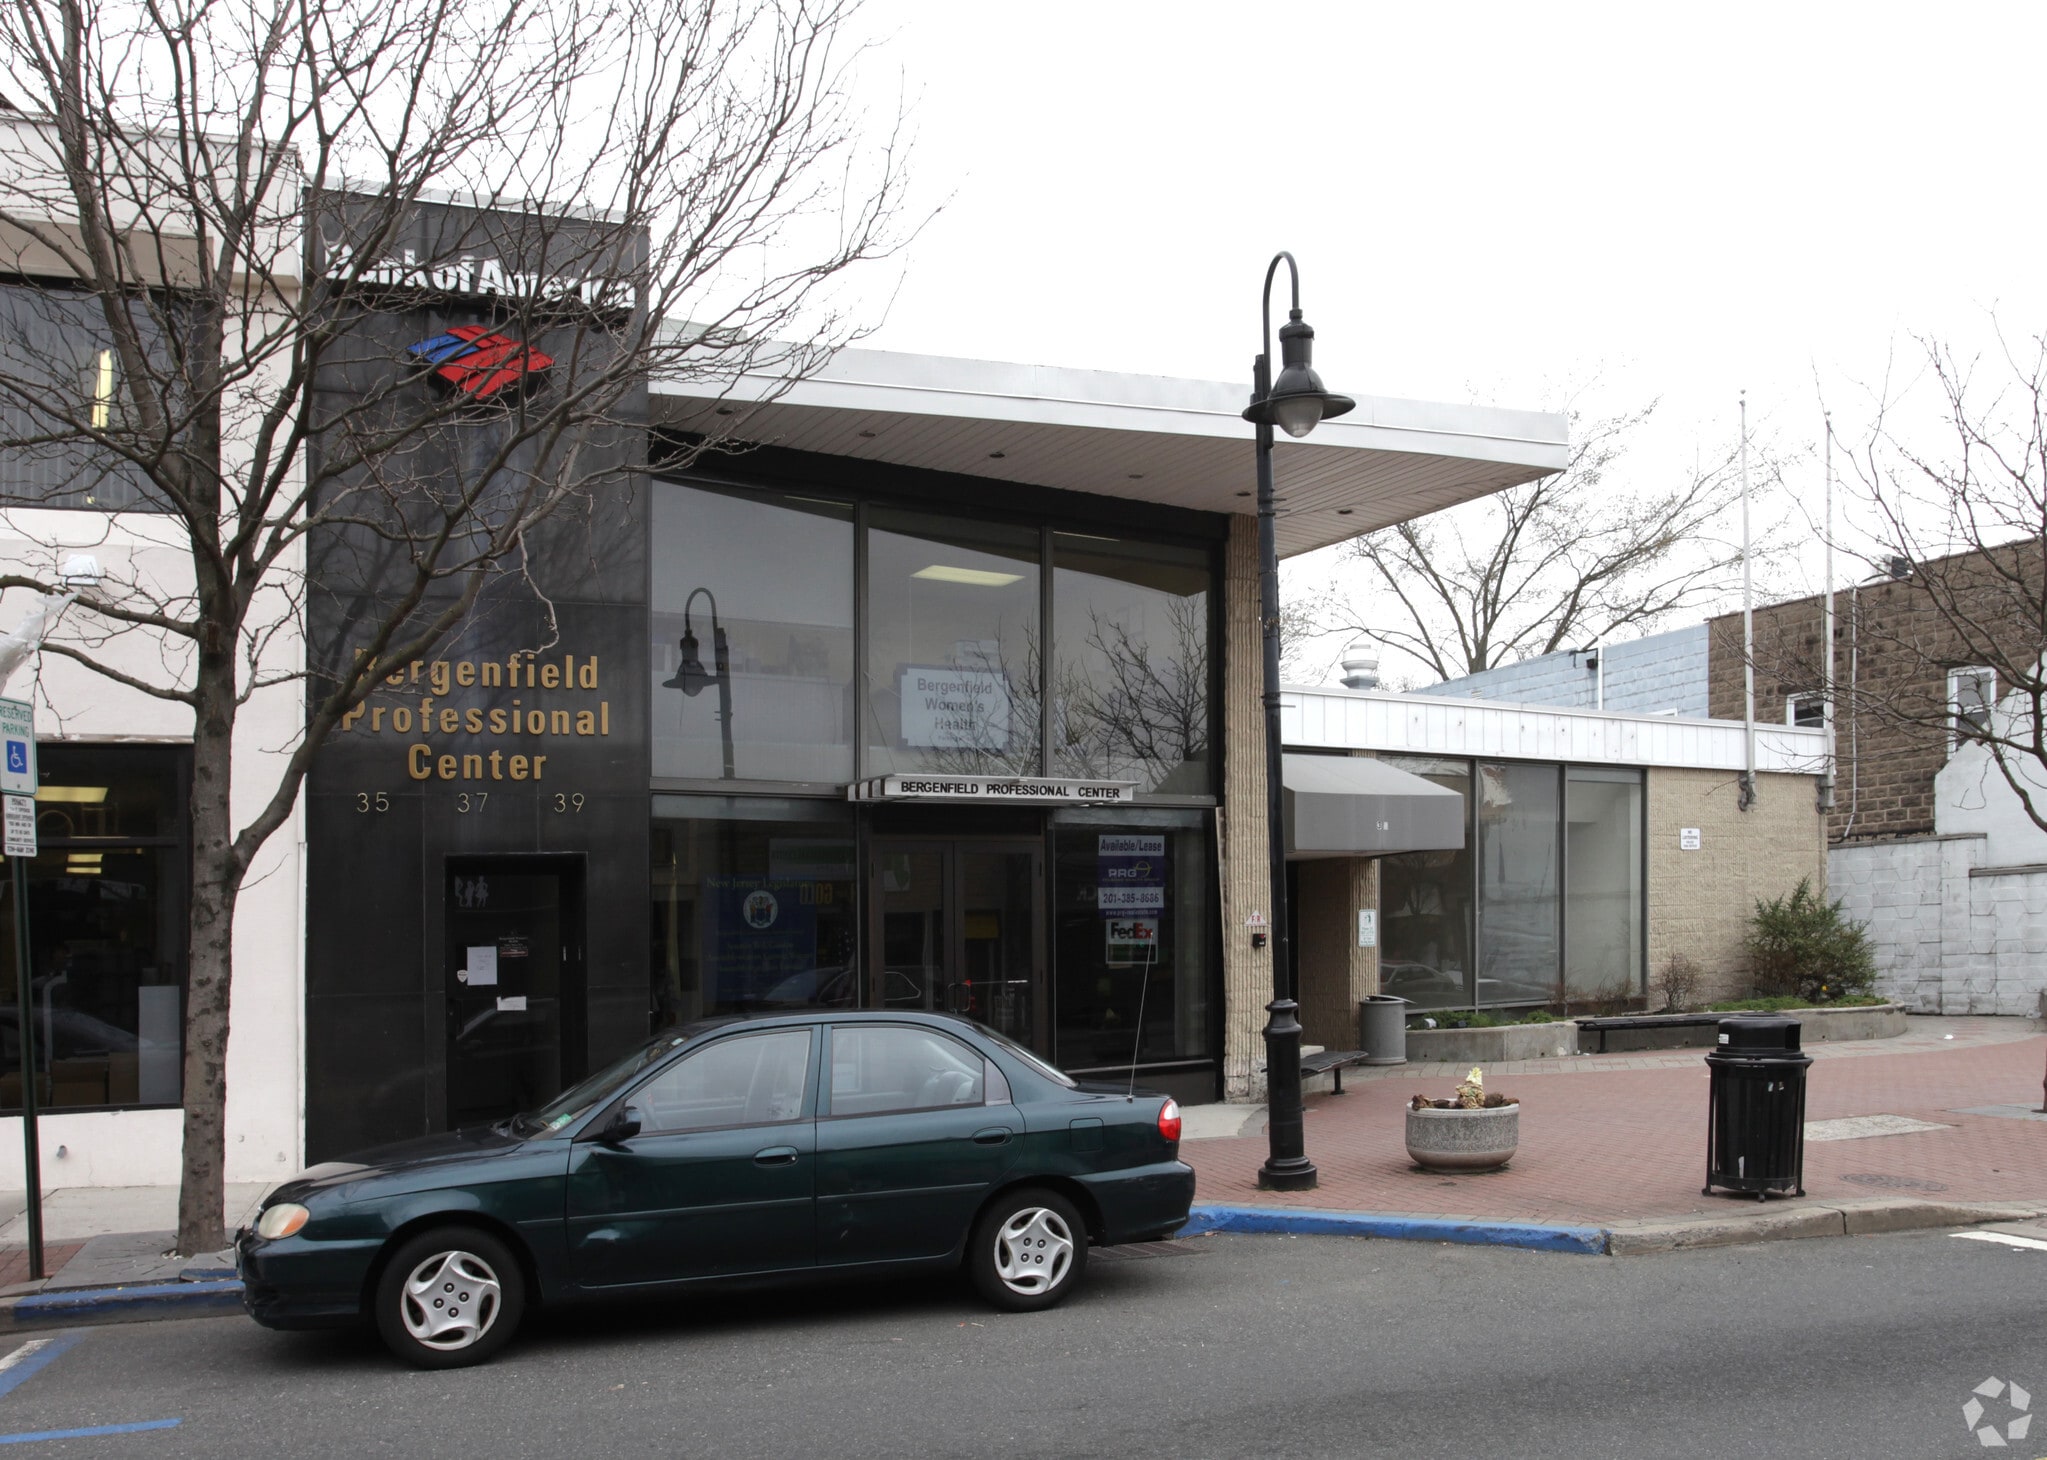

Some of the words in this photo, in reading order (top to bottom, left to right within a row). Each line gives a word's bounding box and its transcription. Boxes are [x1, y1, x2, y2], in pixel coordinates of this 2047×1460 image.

[432, 255, 474, 292] of
[354, 648, 598, 696] ergenfield
[917, 678, 992, 695] Bergenfield
[925, 697, 985, 713] Women's
[0, 706, 32, 723] RESERVED
[342, 697, 609, 736] Professional
[3, 722, 30, 738] PARKING
[935, 717, 976, 731] Health
[408, 744, 546, 781] Center
[900, 782, 979, 794] BERGENFIELD
[986, 783, 1070, 797] PROFESSIONAL
[1078, 786, 1120, 799] CENTER
[357, 792, 390, 813] 35
[457, 792, 488, 813] 37
[554, 792, 586, 813] 39
[1100, 839, 1163, 852] Available/Lease
[1110, 922, 1153, 939] FedEx
